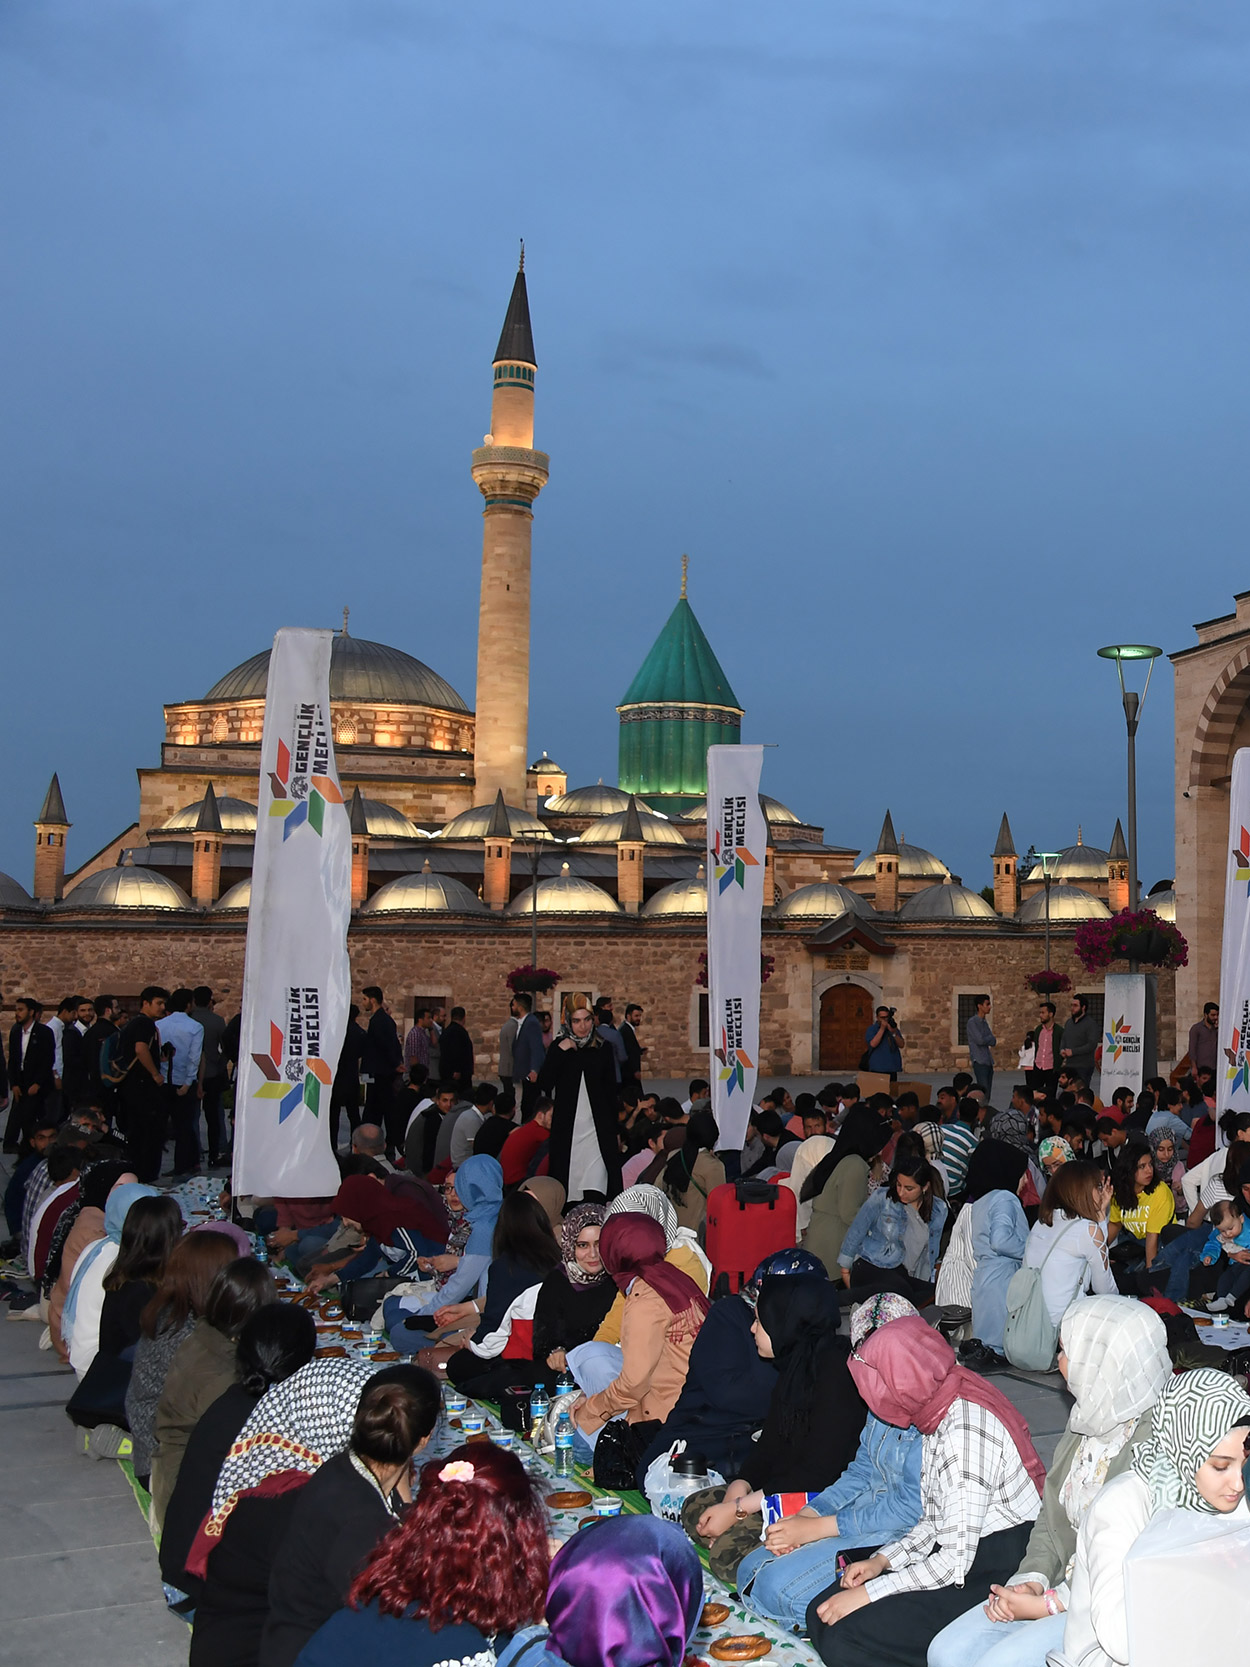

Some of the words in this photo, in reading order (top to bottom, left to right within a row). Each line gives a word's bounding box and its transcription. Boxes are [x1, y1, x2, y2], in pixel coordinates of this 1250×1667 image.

[295, 703, 315, 773] GENÇLİK
[722, 797, 735, 847] GENÇLİK
[734, 796, 746, 846] MECLİSİ
[288, 986, 304, 1056] GENÇLİK
[302, 987, 320, 1057] MECLİSİ
[725, 998, 735, 1049] GENÇLİK
[733, 997, 743, 1049] MECLİSİ
